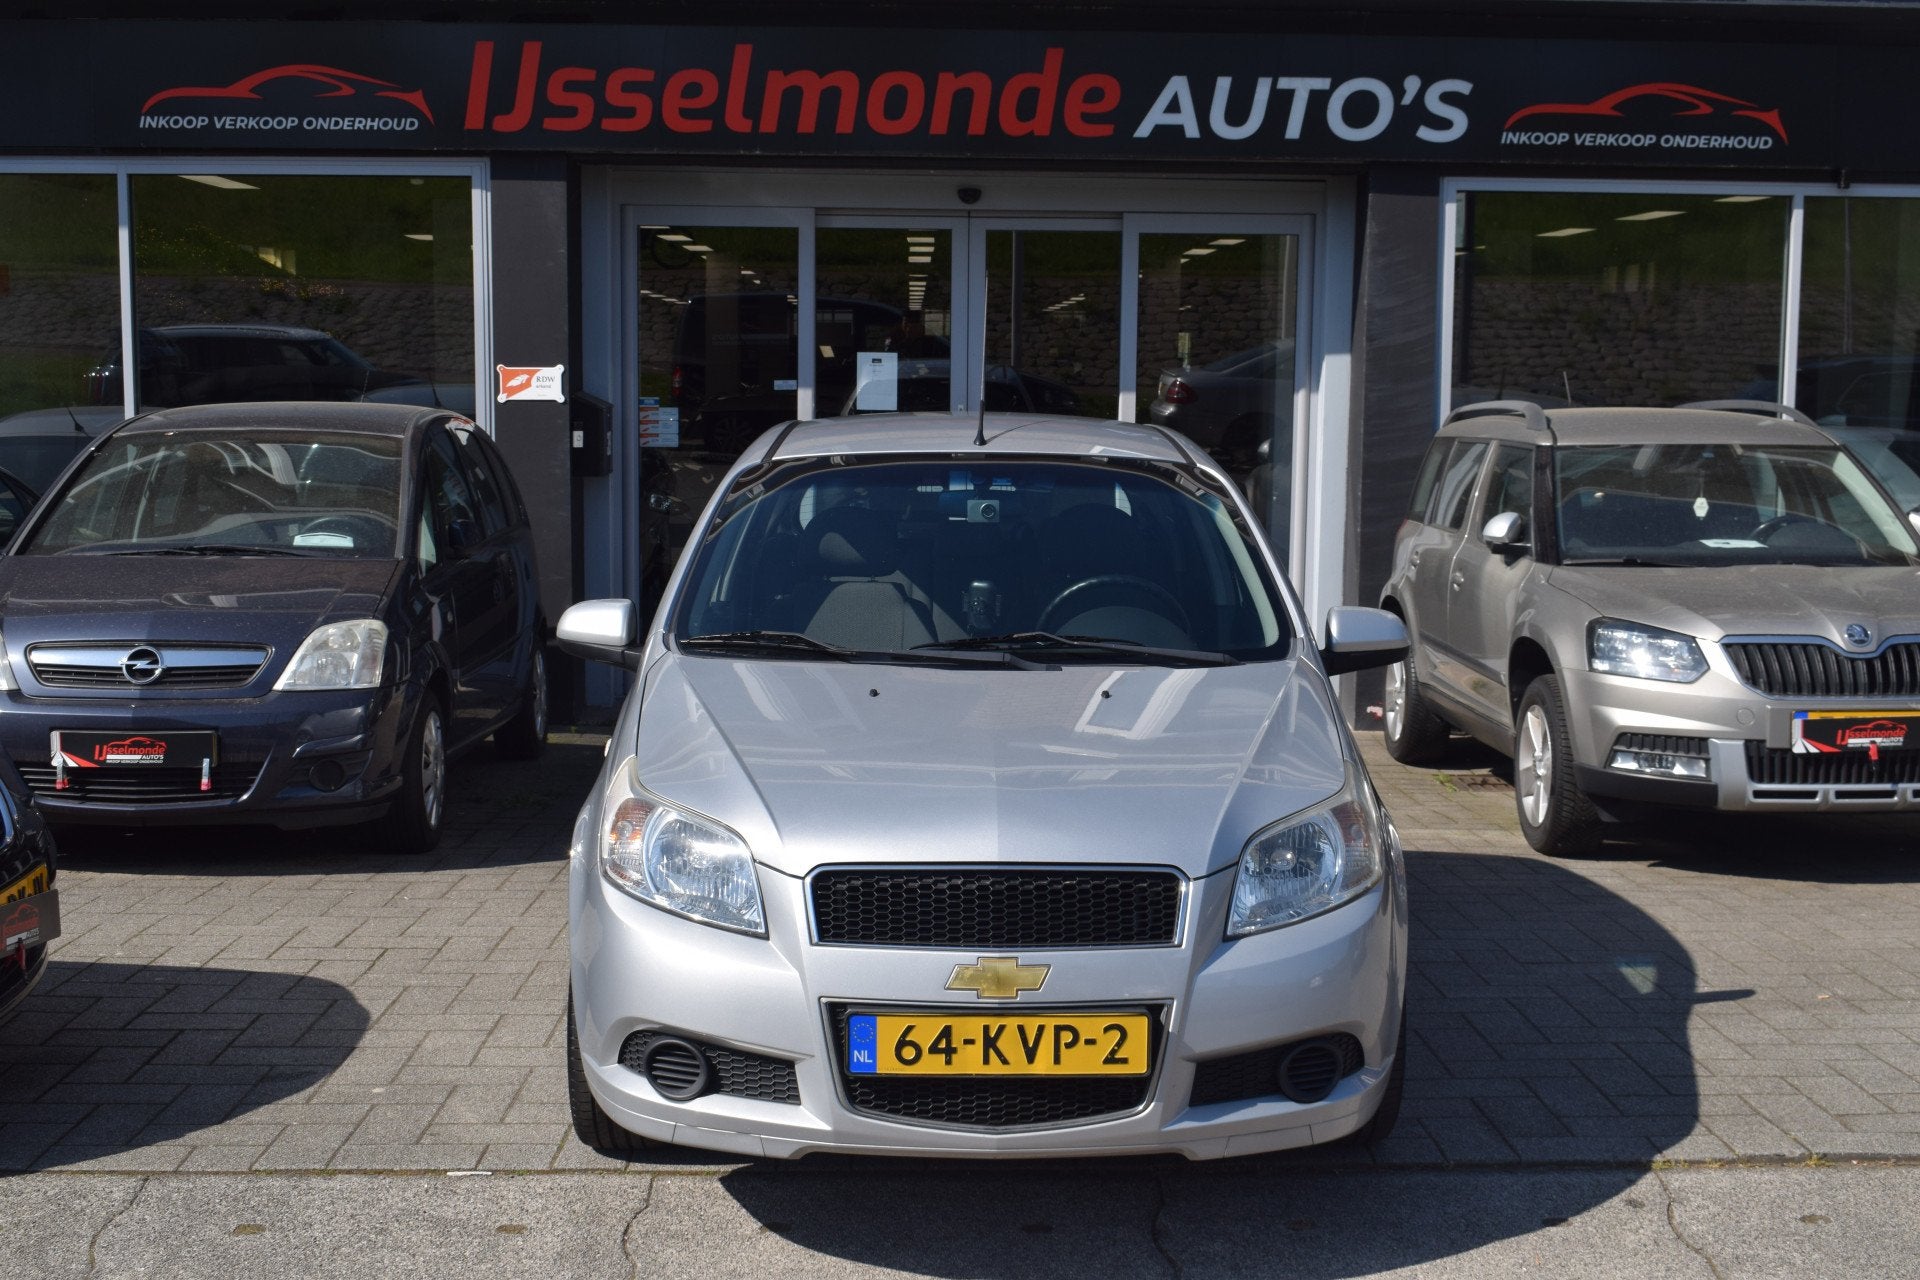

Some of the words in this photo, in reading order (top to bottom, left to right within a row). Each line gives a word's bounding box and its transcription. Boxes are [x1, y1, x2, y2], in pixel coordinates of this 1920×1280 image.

[464, 41, 1121, 137] IJsselmonde
[1133, 75, 1474, 143] AUTO'S
[139, 115, 209, 129] INKOOP
[214, 116, 299, 130] VERKOOP
[302, 117, 419, 131] ONDERHOUD
[1500, 131, 1570, 146] INKOOP
[1575, 133, 1657, 147] VERKOOP
[1660, 134, 1773, 149] ONDERHOUD
[94, 745, 165, 760] IJsselmonde
[894, 1023, 1130, 1066] 64-KVP-2
[853, 1050, 873, 1063] NL
